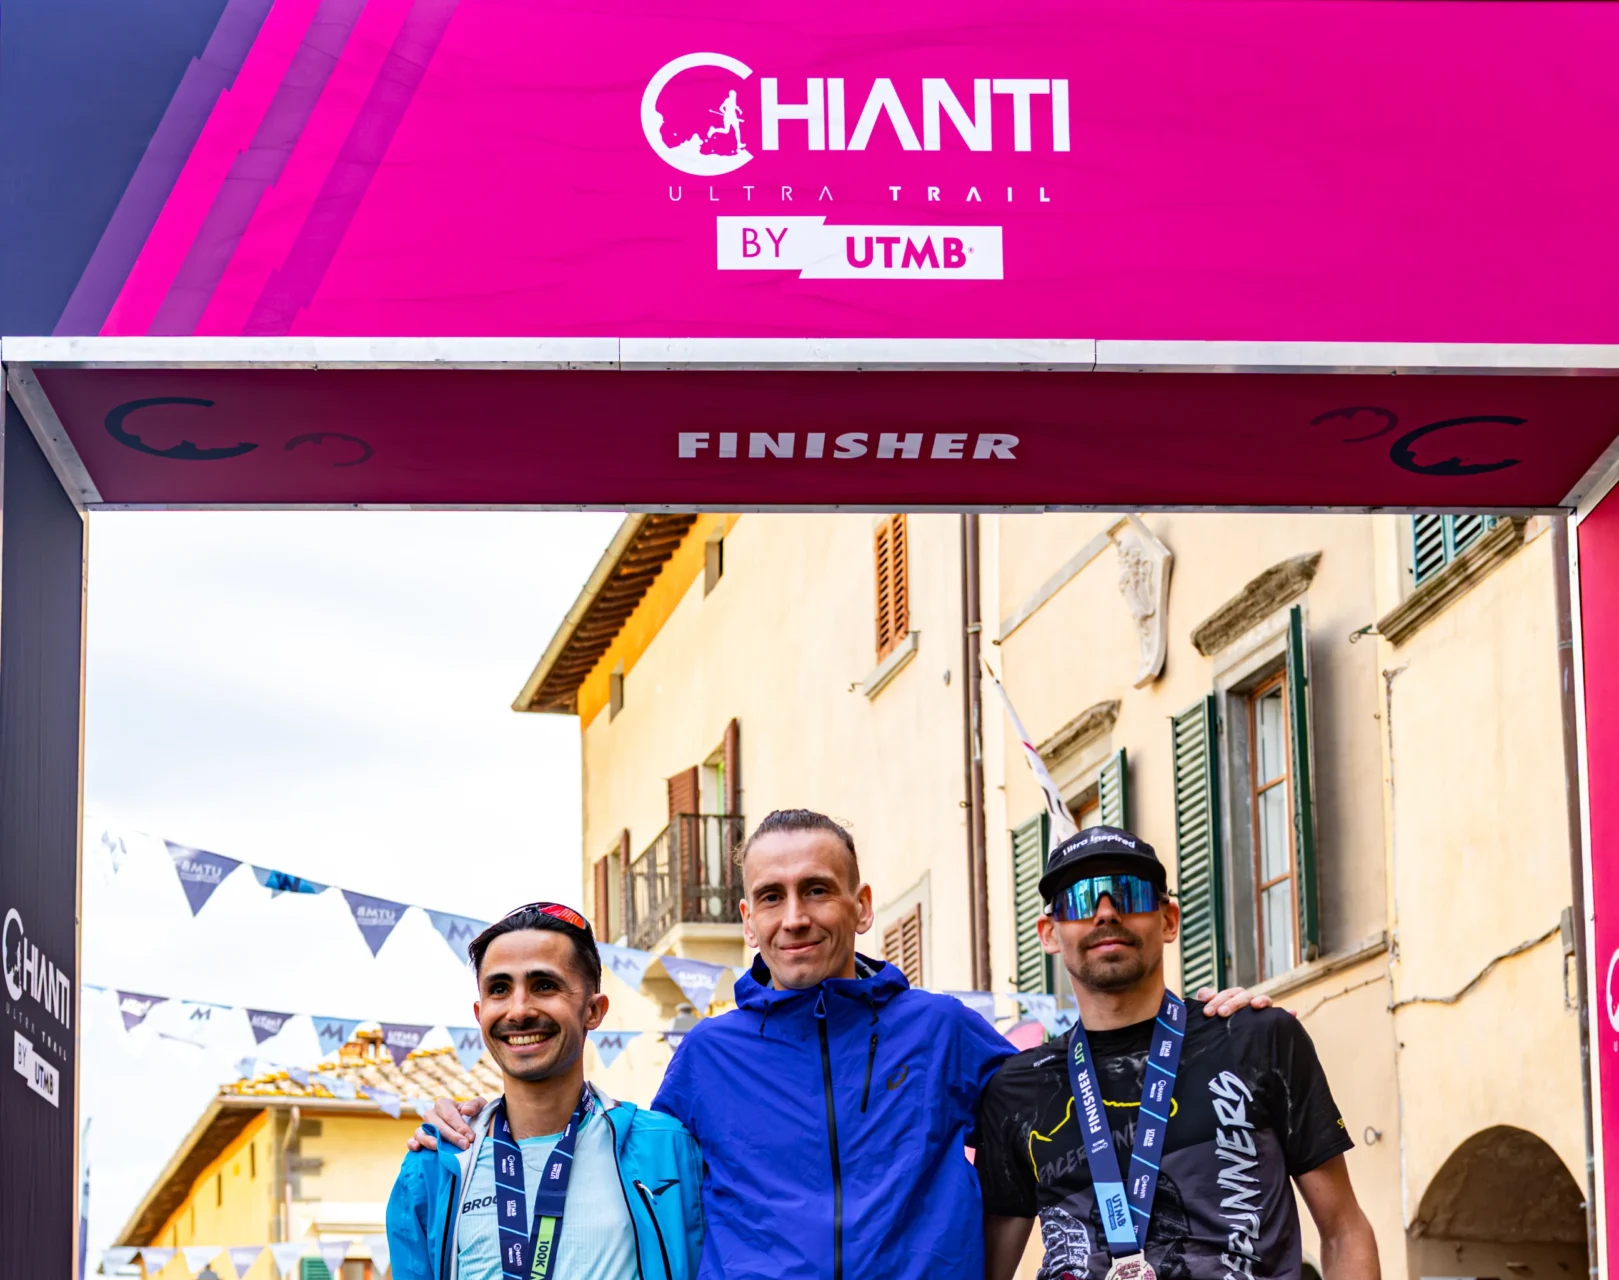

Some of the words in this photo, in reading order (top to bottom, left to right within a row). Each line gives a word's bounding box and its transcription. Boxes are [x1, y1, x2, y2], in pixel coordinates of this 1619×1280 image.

[640, 52, 1071, 176] CHIANTI
[669, 185, 834, 202] ULTRA
[889, 186, 1051, 203] TRAIL
[741, 227, 789, 258] BY
[678, 431, 1020, 460] FINISHER
[2, 908, 71, 1030] CHIANTI
[41, 1030, 68, 1062] TRAIL
[1073, 1041, 1085, 1066] CUT
[18, 1042, 28, 1066] BY
[34, 1061, 55, 1096] UTMB
[1077, 1068, 1103, 1135] FINISHER
[462, 1194, 498, 1214] BRO
[1111, 1193, 1128, 1228] UTMB
[536, 1240, 550, 1268] 100K
